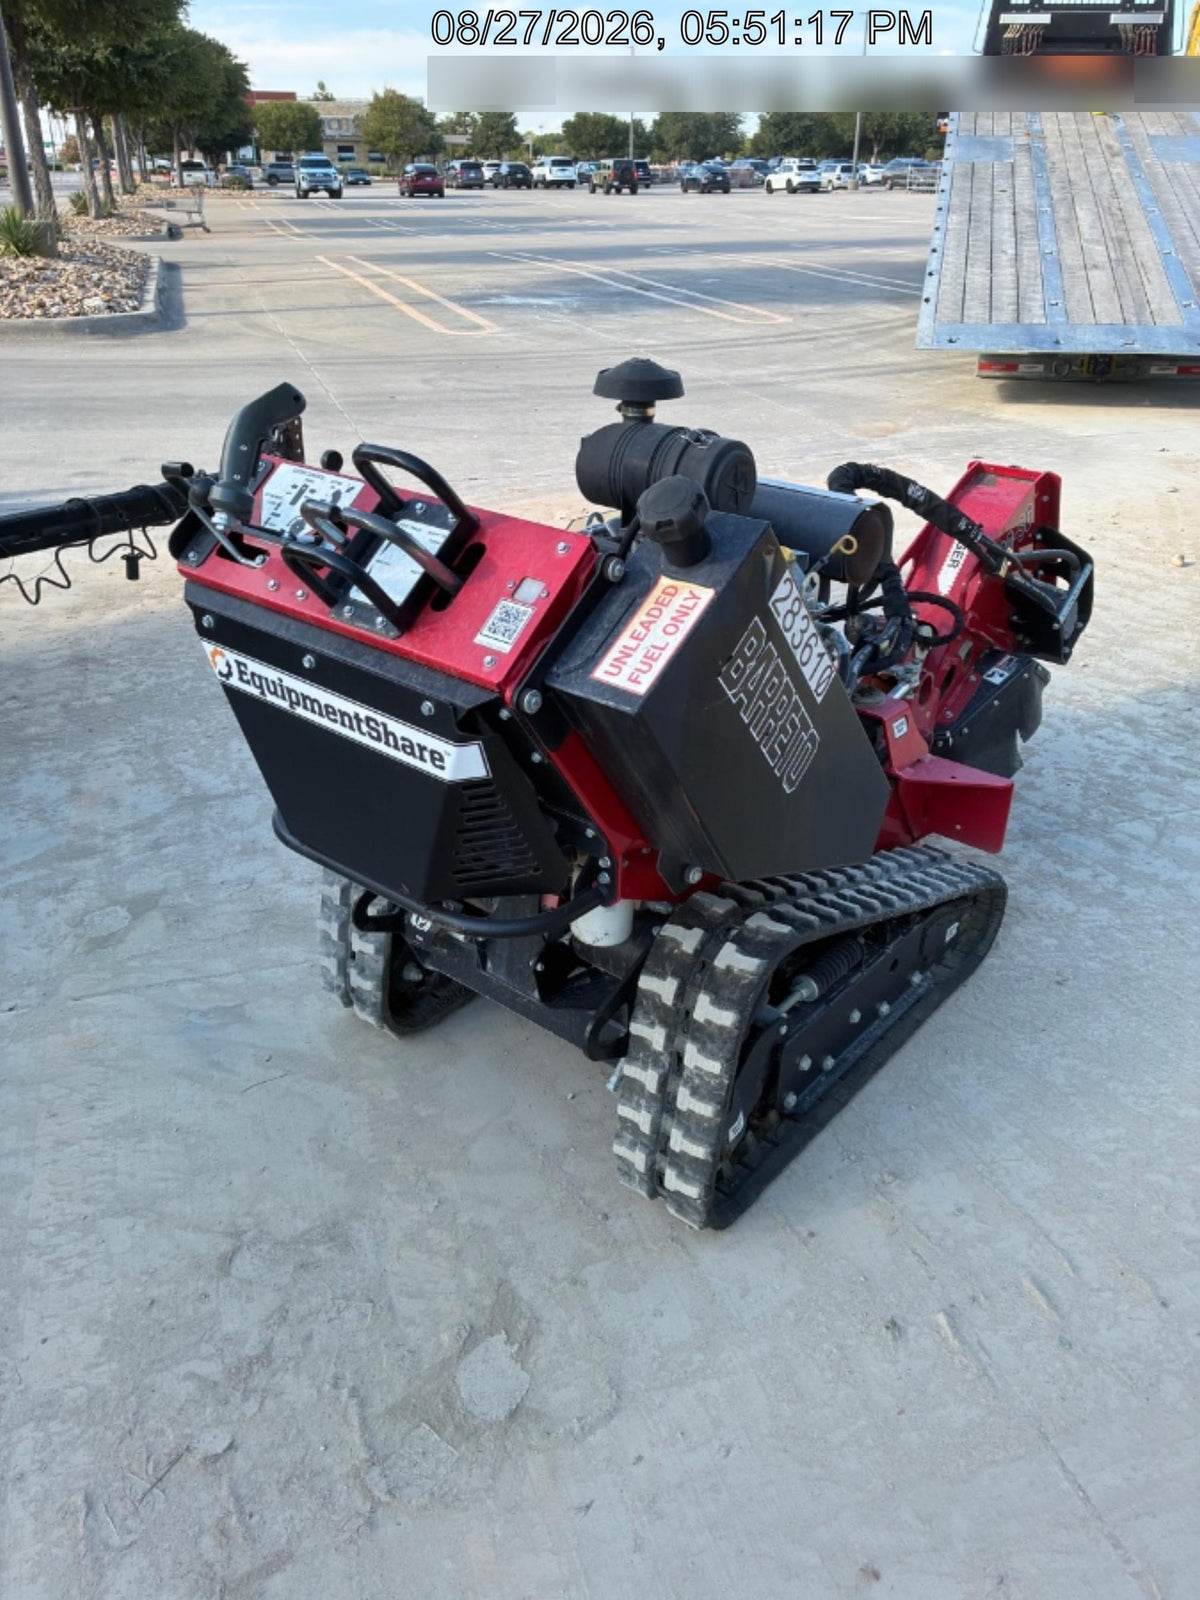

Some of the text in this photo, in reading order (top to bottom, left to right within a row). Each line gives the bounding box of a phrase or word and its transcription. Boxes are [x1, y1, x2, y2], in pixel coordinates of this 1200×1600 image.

[603, 584, 678, 677] UNLEADED
[627, 589, 702, 685] FUEL ONLY
[772, 577, 836, 698] 283610
[234, 659, 446, 771] EquipmentShare
[718, 615, 820, 794] BARRETO
